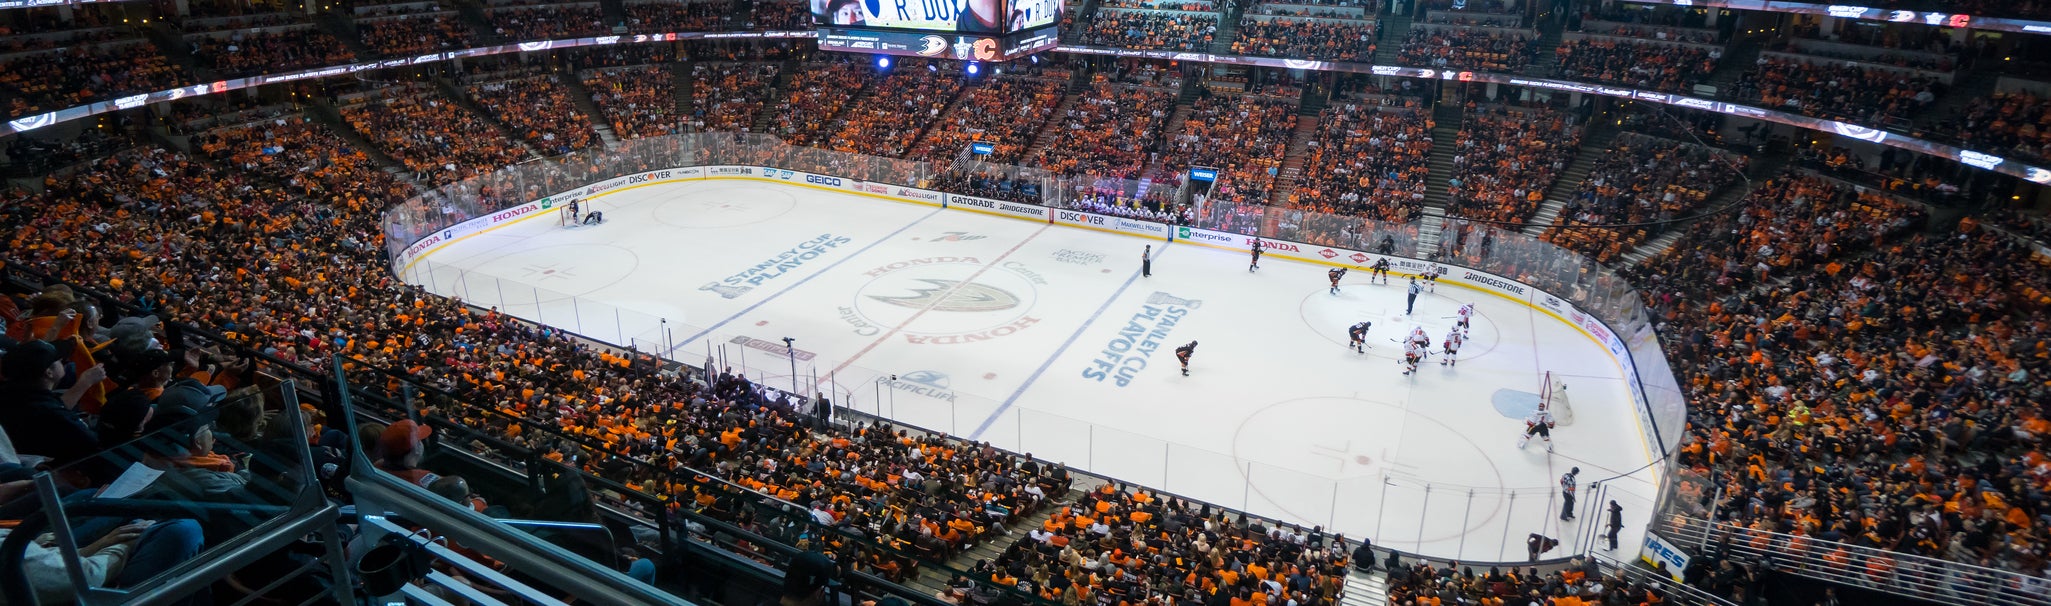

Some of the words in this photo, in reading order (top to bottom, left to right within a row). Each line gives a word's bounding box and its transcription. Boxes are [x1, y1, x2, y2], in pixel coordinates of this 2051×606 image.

[610, 180, 626, 189] LIGHT
[629, 171, 671, 184] DISCOVER
[806, 175, 841, 187] GEICO
[921, 192, 938, 201] LIGHT
[951, 196, 995, 209] GATORADE
[493, 204, 538, 223] HONDA
[999, 203, 1043, 216] BRIDGESTONE
[1060, 212, 1105, 226] DISCOVER
[1120, 221, 1144, 231] MAXWELL
[408, 235, 441, 258] HONDA
[1245, 238, 1300, 253] HONDA
[723, 247, 799, 286] STANLEY
[798, 232, 832, 251] CUP
[746, 235, 853, 286] PLAYOFFS
[862, 256, 982, 278] HONDA
[1002, 260, 1048, 286] Center
[1464, 271, 1524, 295] BRIDGESTONE
[837, 305, 881, 337] Center
[903, 315, 1042, 345] HONDA
[1136, 305, 1188, 358] STANLEY
[1081, 304, 1163, 383] PLAYOFFS
[1112, 355, 1147, 388] CUP
[877, 376, 928, 396] PACIFIC
[925, 388, 958, 403] LIFE
